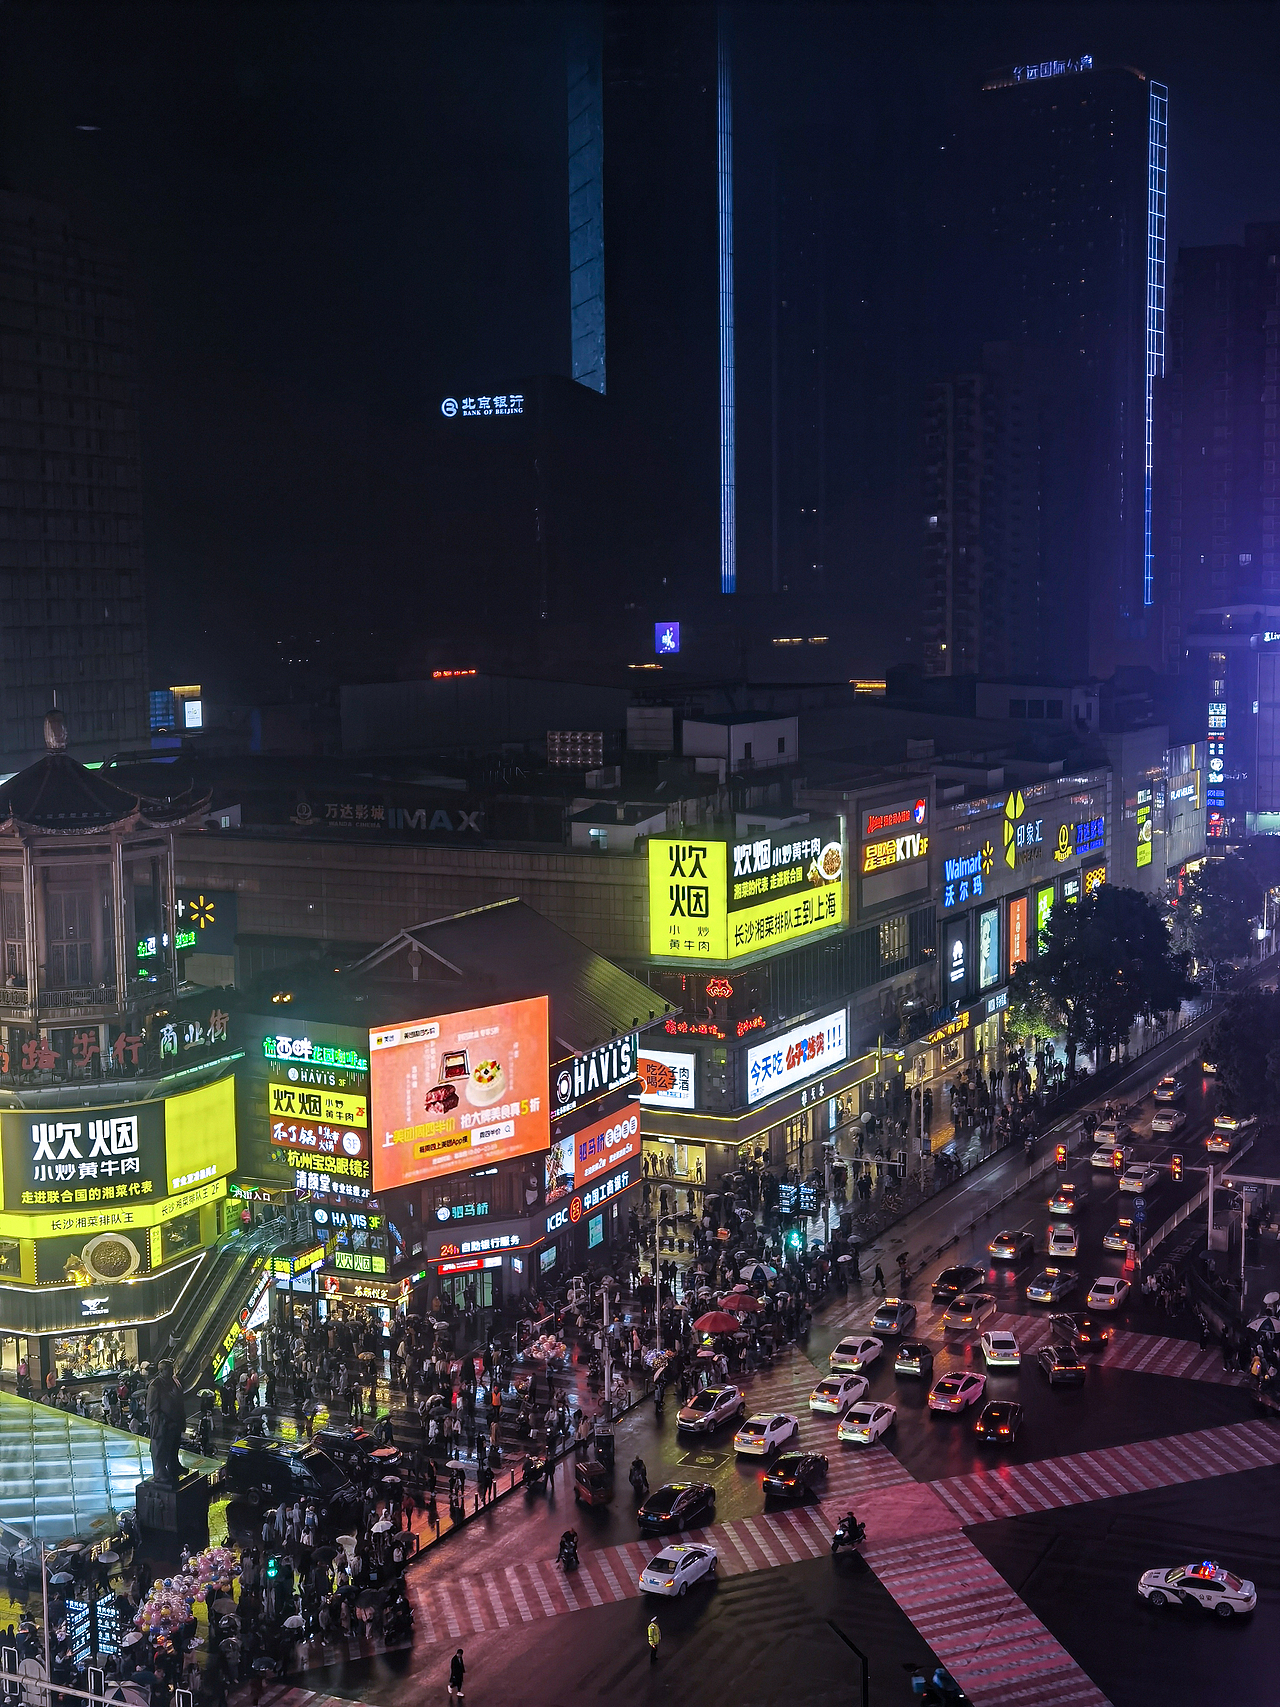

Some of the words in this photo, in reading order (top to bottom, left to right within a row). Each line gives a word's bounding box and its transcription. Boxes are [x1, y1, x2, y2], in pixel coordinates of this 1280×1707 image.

[462, 395, 524, 409] 北京银行
[495, 407, 523, 415] BEIJING
[325, 804, 385, 820] 万达影城
[388, 808, 481, 832] IMAX
[1017, 820, 1043, 847] 印象汇
[733, 838, 771, 877] 炊烟
[772, 837, 821, 867] 小炒黄牛肉
[945, 851, 982, 882] Walmart
[669, 845, 709, 918] 炊烟
[733, 880, 769, 900] 湘菜的代表
[769, 866, 803, 889] 走进联合国
[945, 874, 983, 908] 沃尔玛
[669, 925, 709, 938] 小炒
[735, 892, 836, 947] 长沙湘菜排队王到上海
[669, 939, 710, 952] 黄牛肉
[301, 1068, 336, 1085] HAVIS
[338, 1079, 347, 1087] 3F
[574, 1036, 631, 1098] HAVIS
[273, 1089, 322, 1117] 炊烟
[326, 1110, 354, 1122] 黄牛肉
[31, 1115, 139, 1161] 炊烟
[34, 1157, 140, 1182] 小炒黄牛肉
[287, 1149, 363, 1178] 杭州宝岛眼镜
[21, 1180, 153, 1204] 走进联合国的湘菜代表
[296, 1170, 331, 1192] 清颜堂
[361, 1189, 370, 1198] 2F
[584, 1171, 629, 1210] 中国工商银行
[161, 1187, 209, 1215] 长沙湘菜排队王
[211, 1183, 220, 1196] 2F
[51, 1212, 134, 1230] 长沙湘菜排队王
[368, 1215, 381, 1229] 3F
[546, 1207, 569, 1232] ICBC
[461, 1234, 520, 1253] 自助银行服务
[336, 1253, 371, 1271] 炊烟
